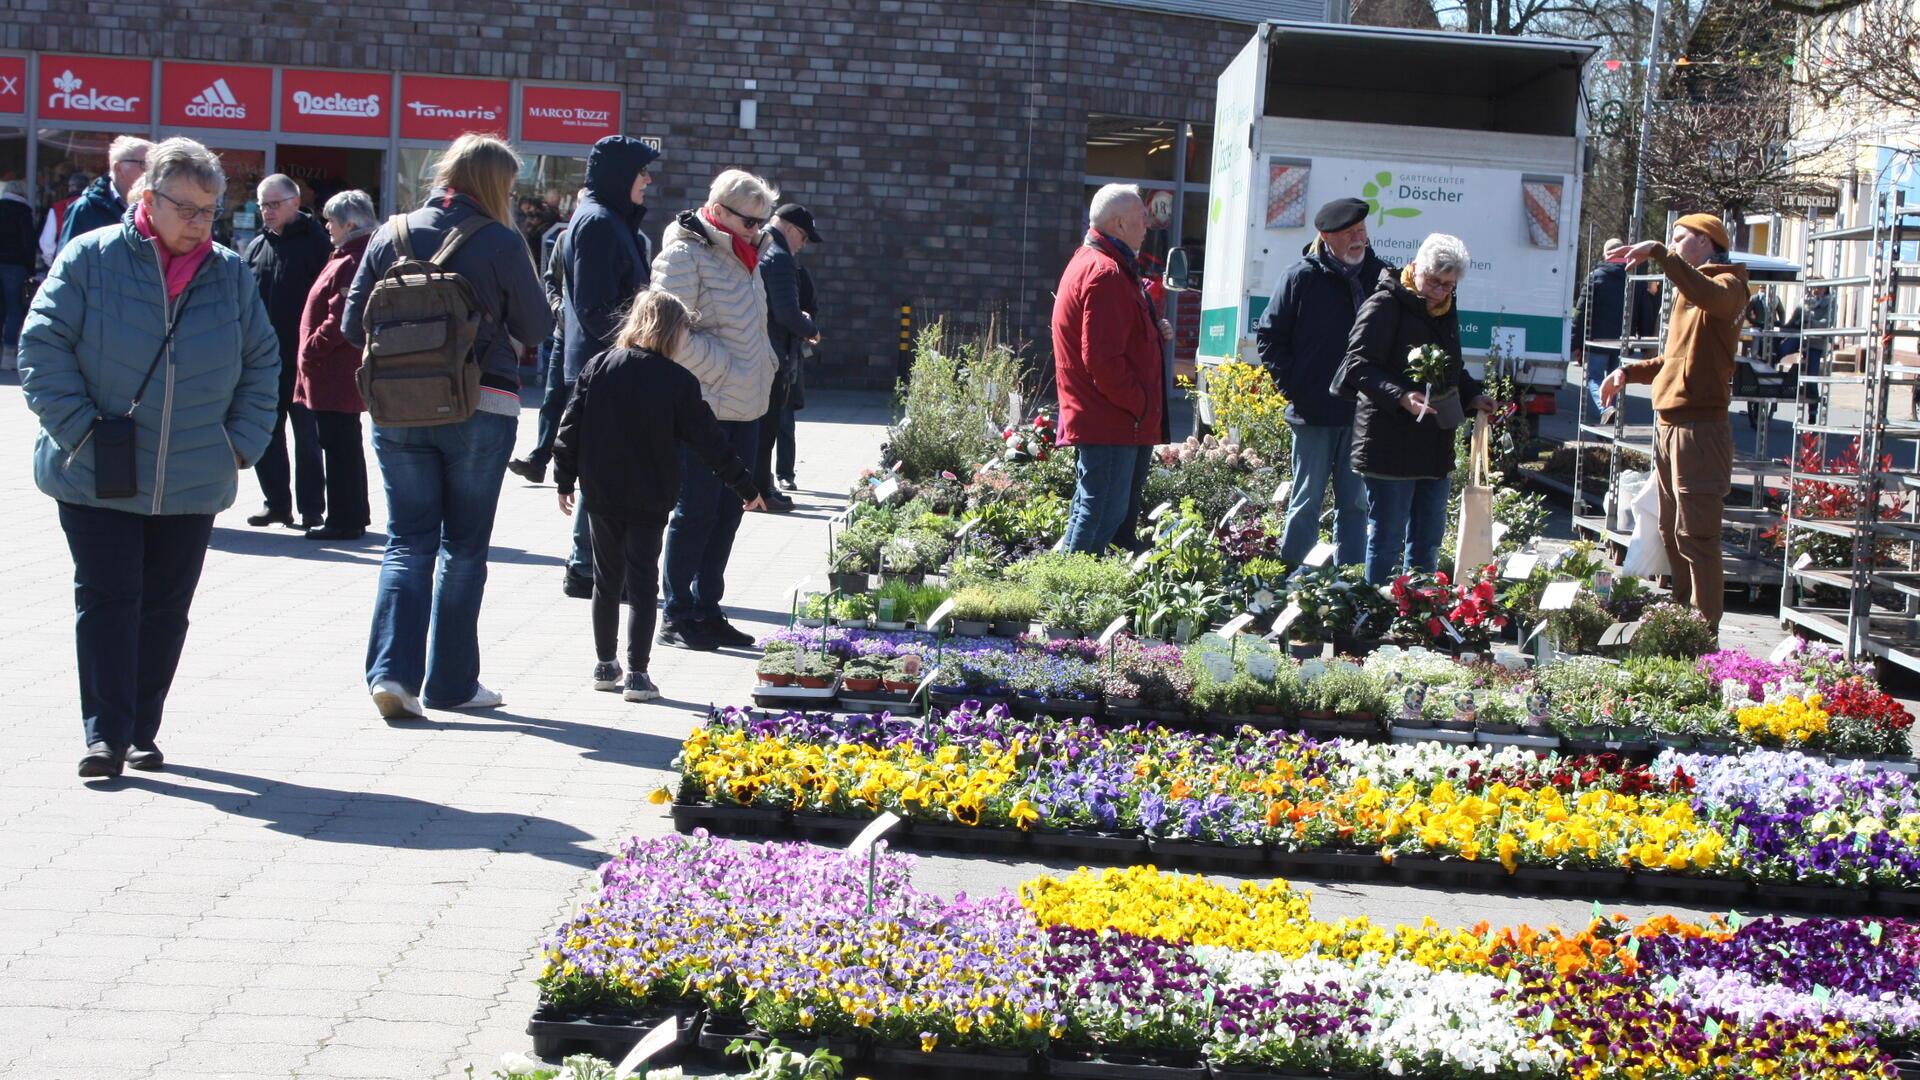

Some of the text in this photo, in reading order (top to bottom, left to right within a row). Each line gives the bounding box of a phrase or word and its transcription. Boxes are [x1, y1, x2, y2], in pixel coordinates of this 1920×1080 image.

[48, 87, 140, 113] rieker
[293, 91, 380, 117] Dockers
[185, 102, 246, 119] adidas
[407, 101, 497, 120] Tamaris
[529, 107, 609, 120] MARCO TOZZI
[1400, 174, 1465, 185] GARTENCENTER
[1399, 185, 1464, 203] Döscher
